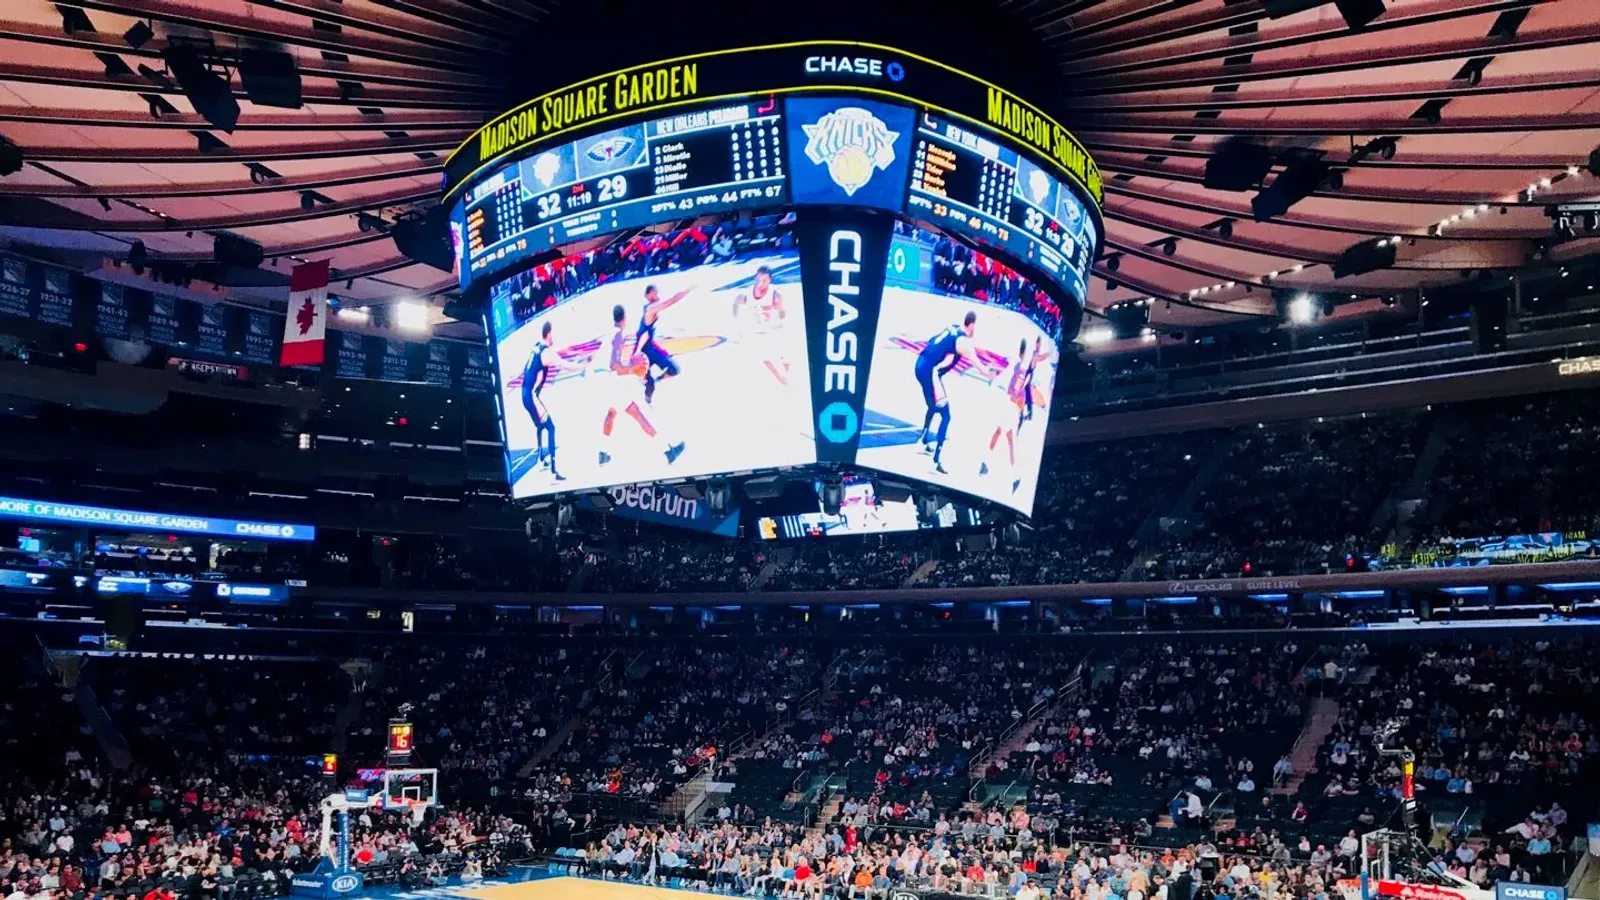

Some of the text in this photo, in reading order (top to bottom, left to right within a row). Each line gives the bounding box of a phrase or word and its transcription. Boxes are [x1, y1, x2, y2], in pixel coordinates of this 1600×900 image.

[805, 55, 883, 76] CHASE
[480, 64, 698, 161] MADISON SQUARE GARDEN
[813, 116, 887, 157] KNICKS
[988, 87, 1050, 149] MADISON
[1054, 126, 1088, 176] SQUARE
[538, 192, 562, 219] 32
[597, 175, 627, 202] 29
[678, 198, 694, 210] 43
[722, 192, 738, 203] 44
[765, 186, 782, 197] 67
[1024, 207, 1044, 236] 32
[824, 230, 862, 395] CHASE
[610, 484, 697, 519] pectrum
[34, 504, 51, 515] OF
[54, 506, 111, 520] MADISON
[113, 512, 159, 526] SQUARE
[161, 516, 208, 530] GARDEN
[236, 522, 281, 534] CHASE
[396, 735, 407, 748] 16
[336, 879, 354, 889] KIA
[1505, 889, 1544, 898] CHASE
